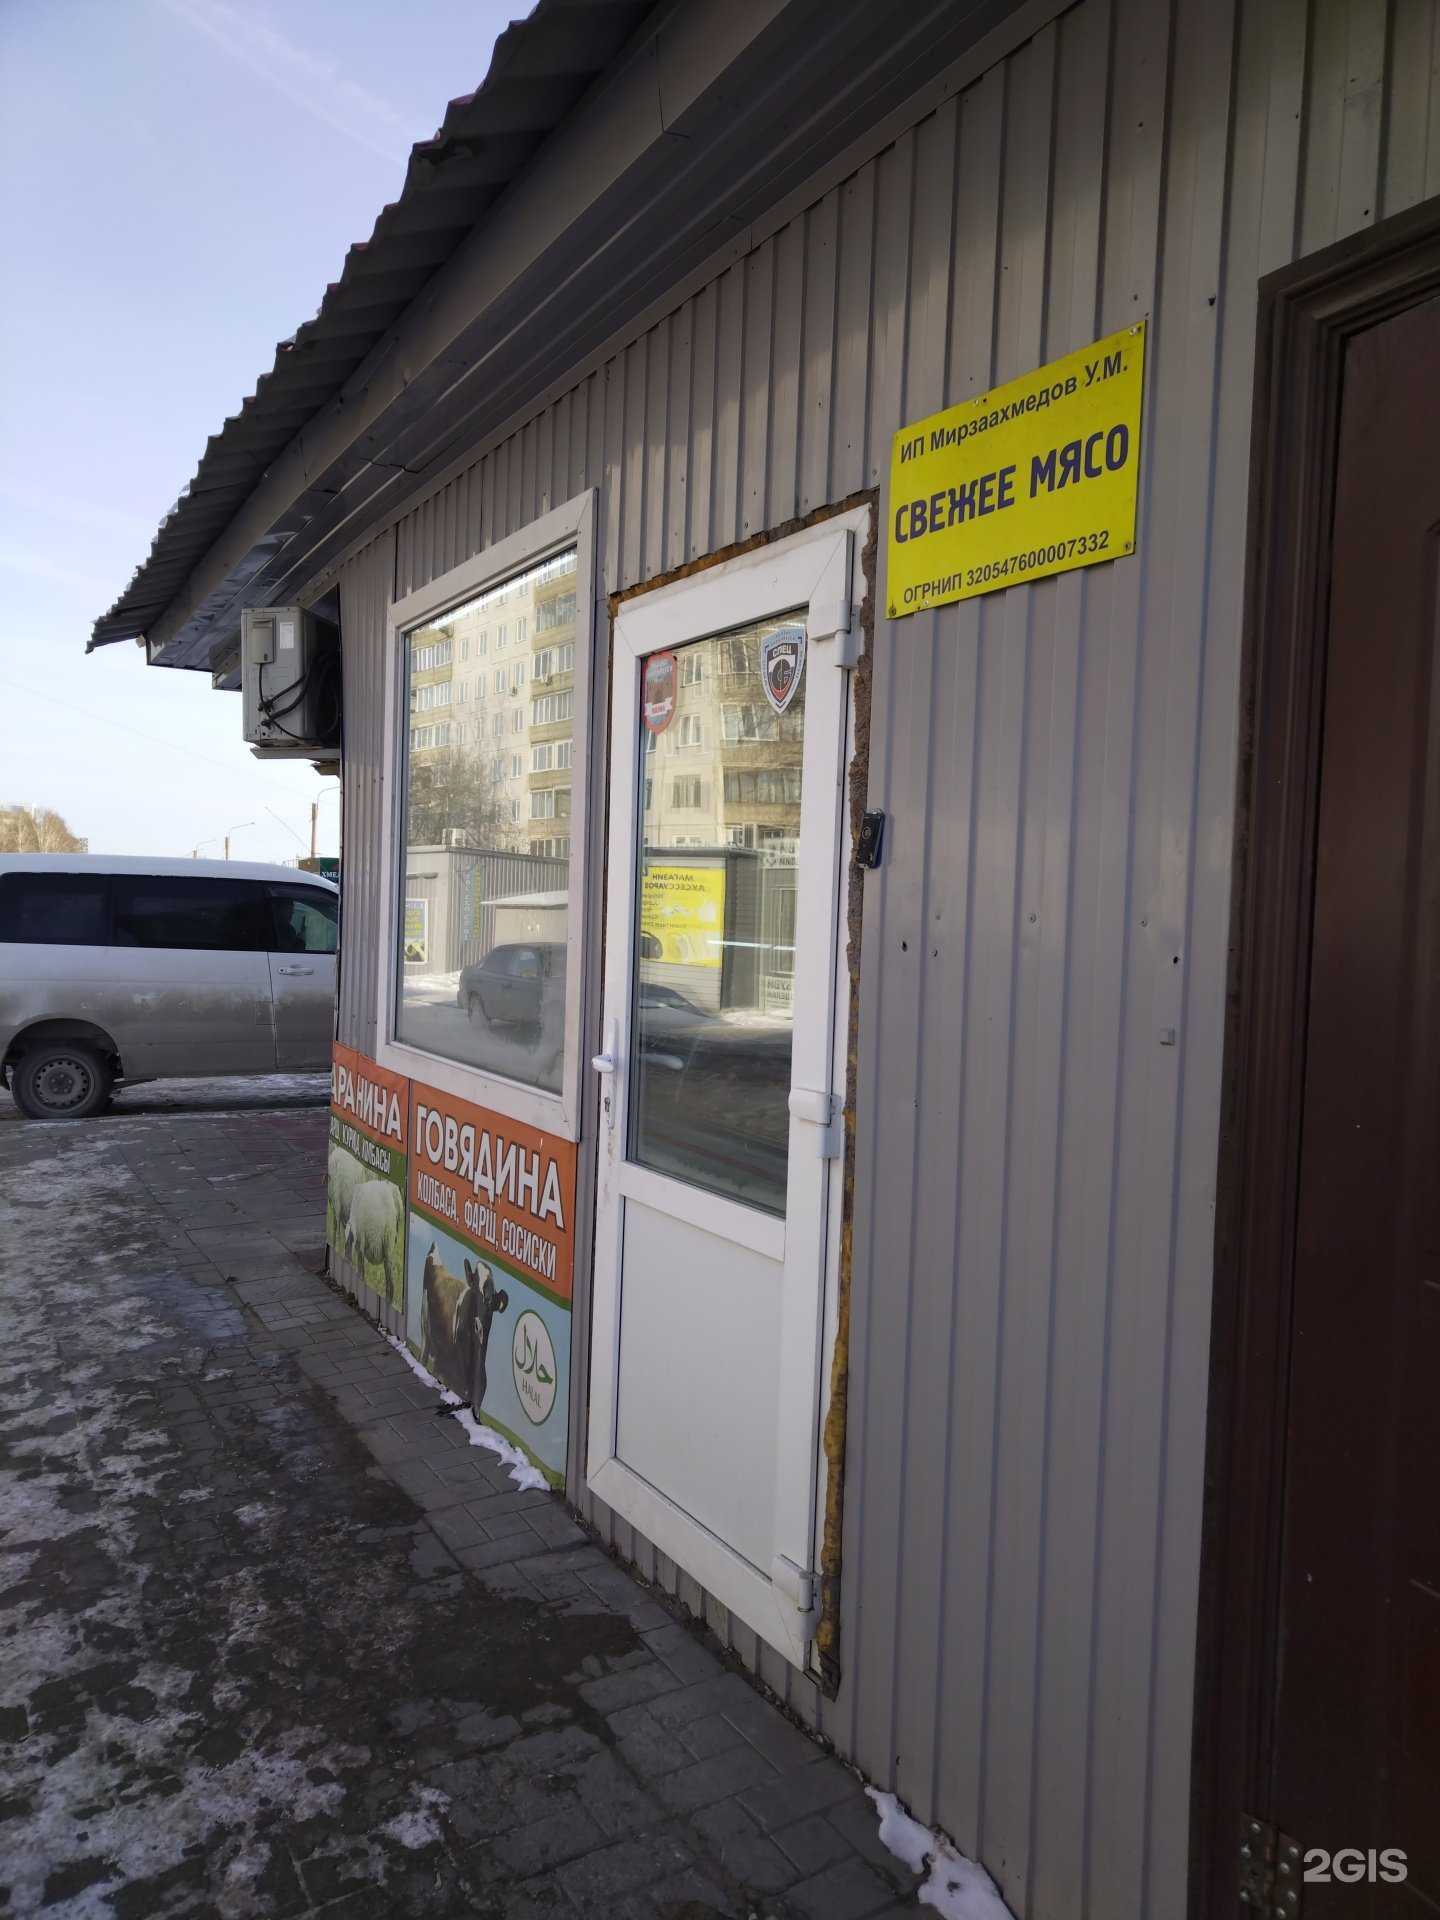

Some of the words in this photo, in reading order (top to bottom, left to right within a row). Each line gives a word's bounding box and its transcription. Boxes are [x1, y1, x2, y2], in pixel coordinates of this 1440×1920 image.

[900, 437, 925, 464] ИП
[930, 376, 1077, 453] Мирзаахмедов
[1084, 351, 1128, 388] У.М.
[895, 464, 1017, 544] СВЕЖЕЕ
[1029, 423, 1129, 499] МЯСО
[903, 573, 962, 605] ОГРНИП
[966, 530, 1110, 587] 320547600007332
[415, 1103, 566, 1231] ГОВЯДИНА
[417, 1171, 460, 1224] КОЛБАСА,
[464, 1198, 499, 1250] ФАРШ,
[501, 1217, 556, 1281] СОСИСКИ
[521, 1377, 543, 1409] HALAL
